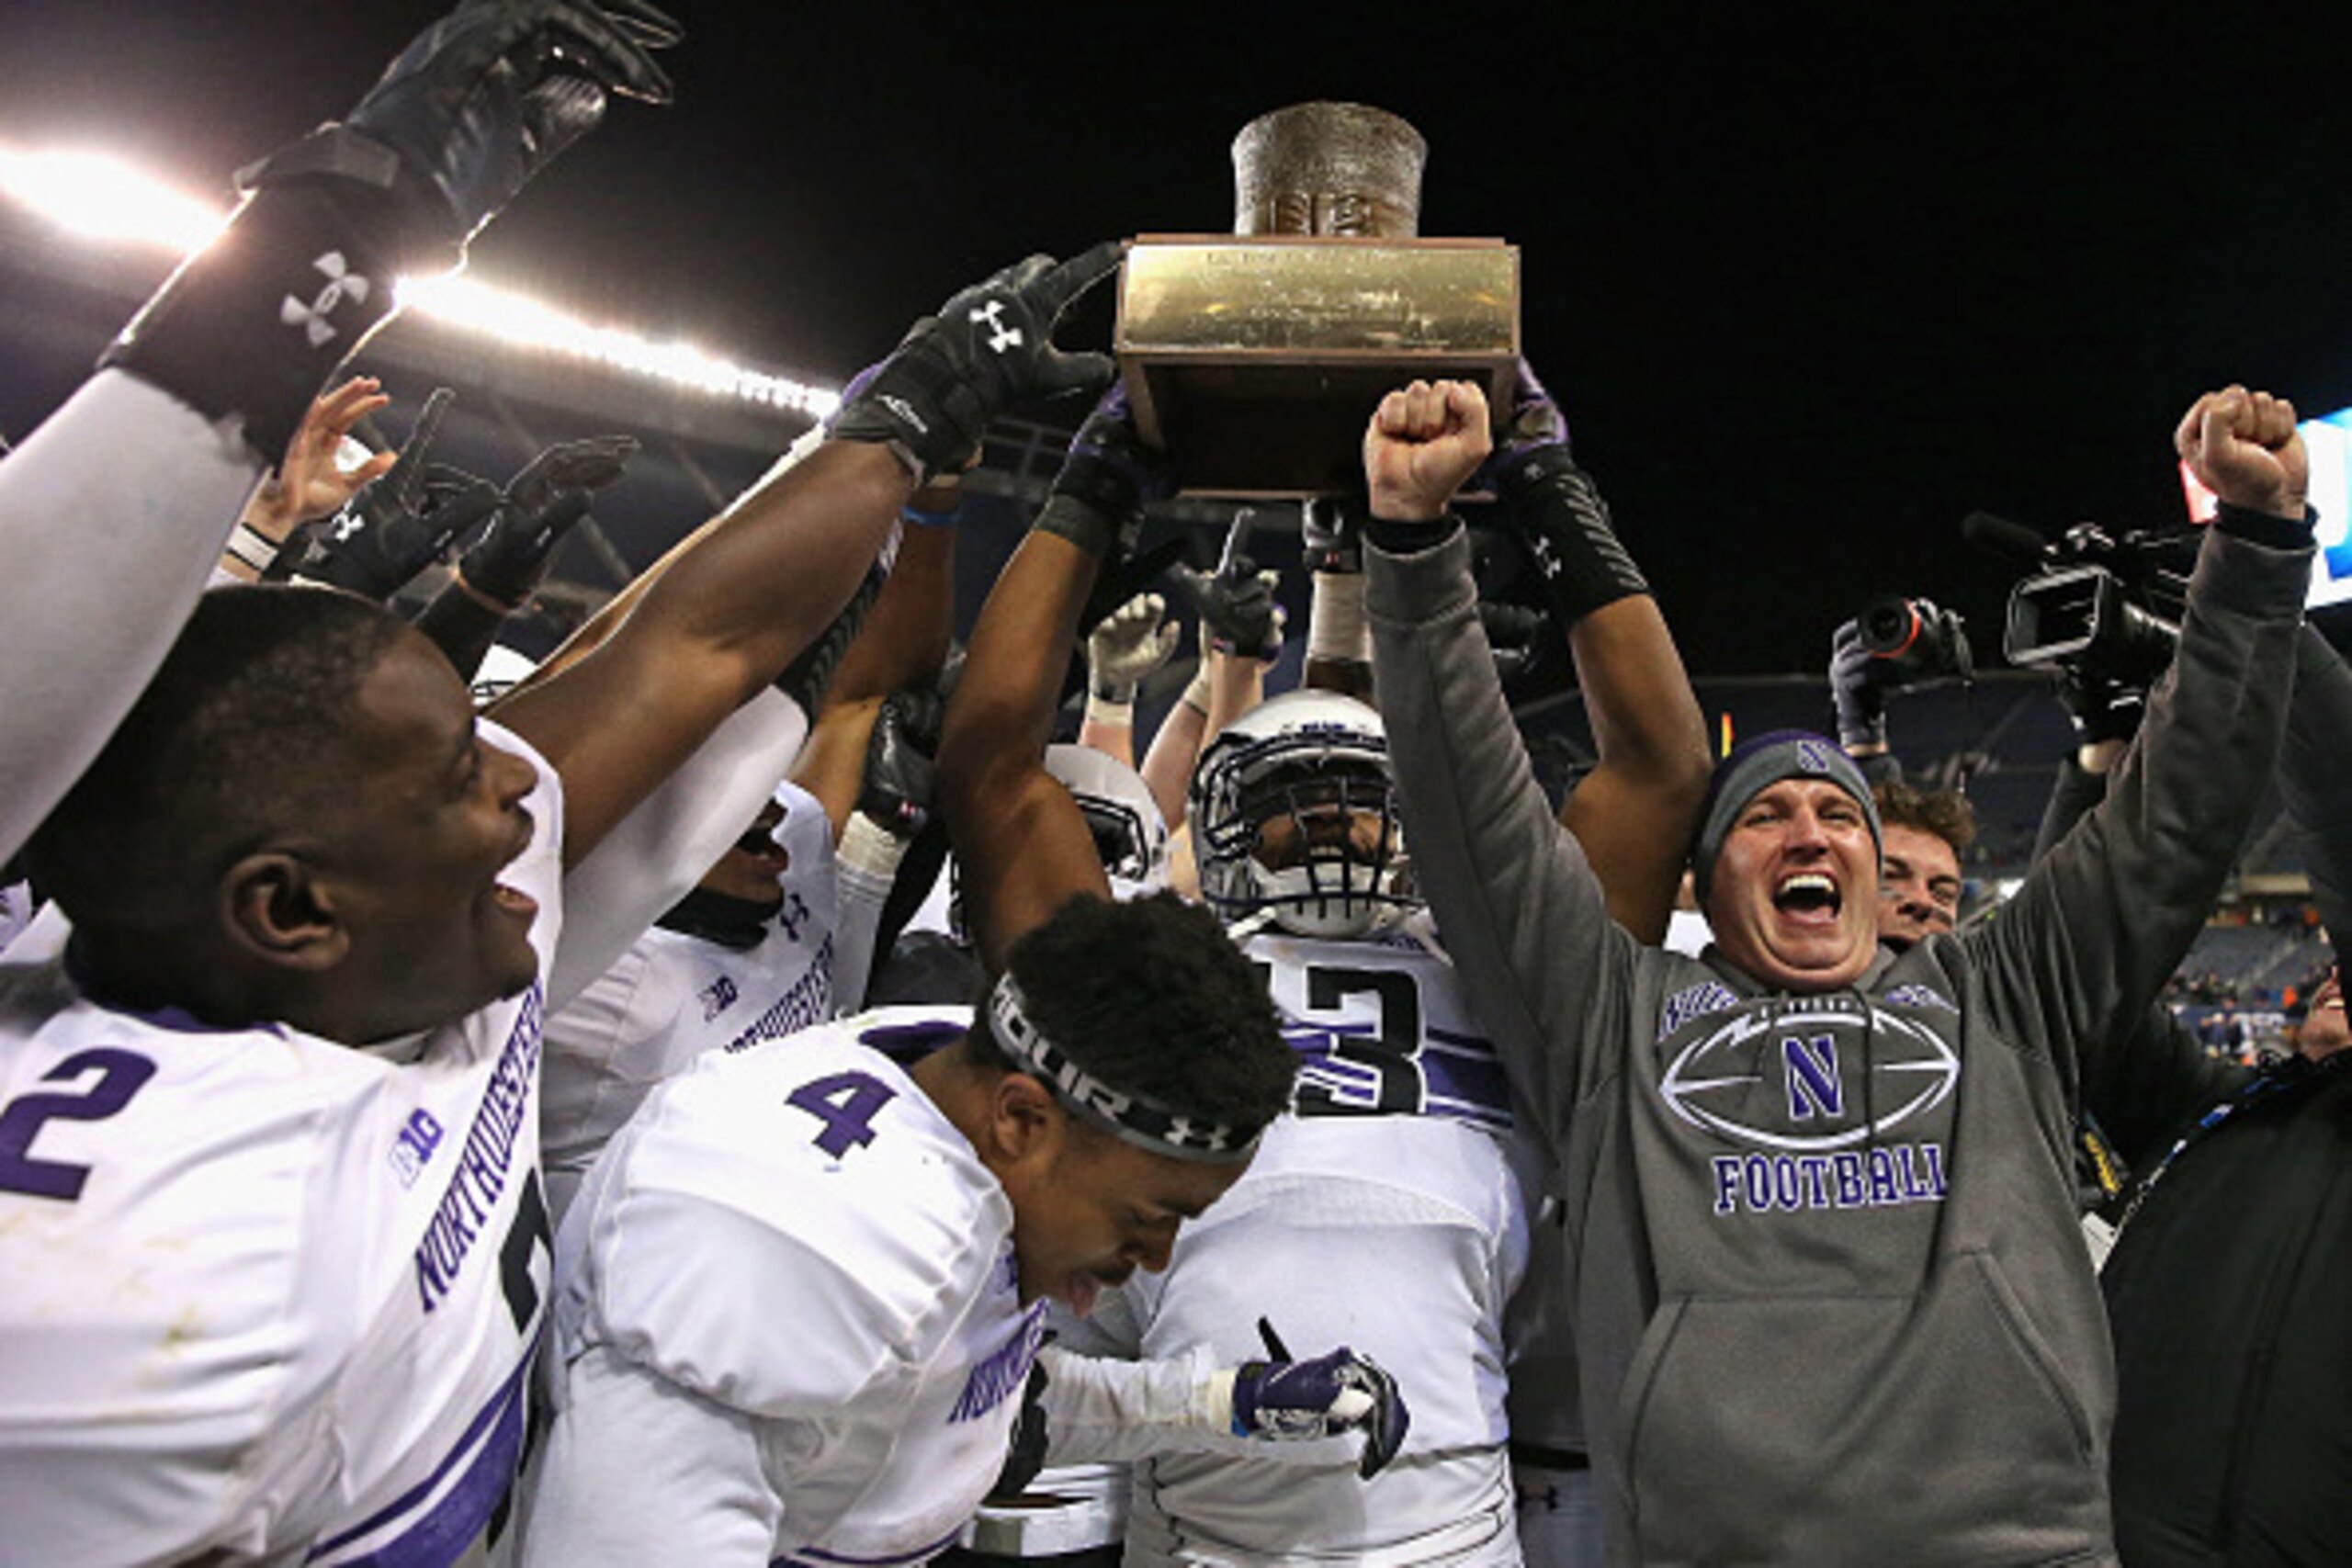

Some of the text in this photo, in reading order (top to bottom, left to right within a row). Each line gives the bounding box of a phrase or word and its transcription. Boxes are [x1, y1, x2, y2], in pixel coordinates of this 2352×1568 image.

[1797, 740, 1830, 772] N
[784, 1069, 899, 1160] 4
[1781, 1033, 1843, 1122] N
[0, 1047, 158, 1203] 2
[1712, 1144, 1949, 1217] FOOTBALL
